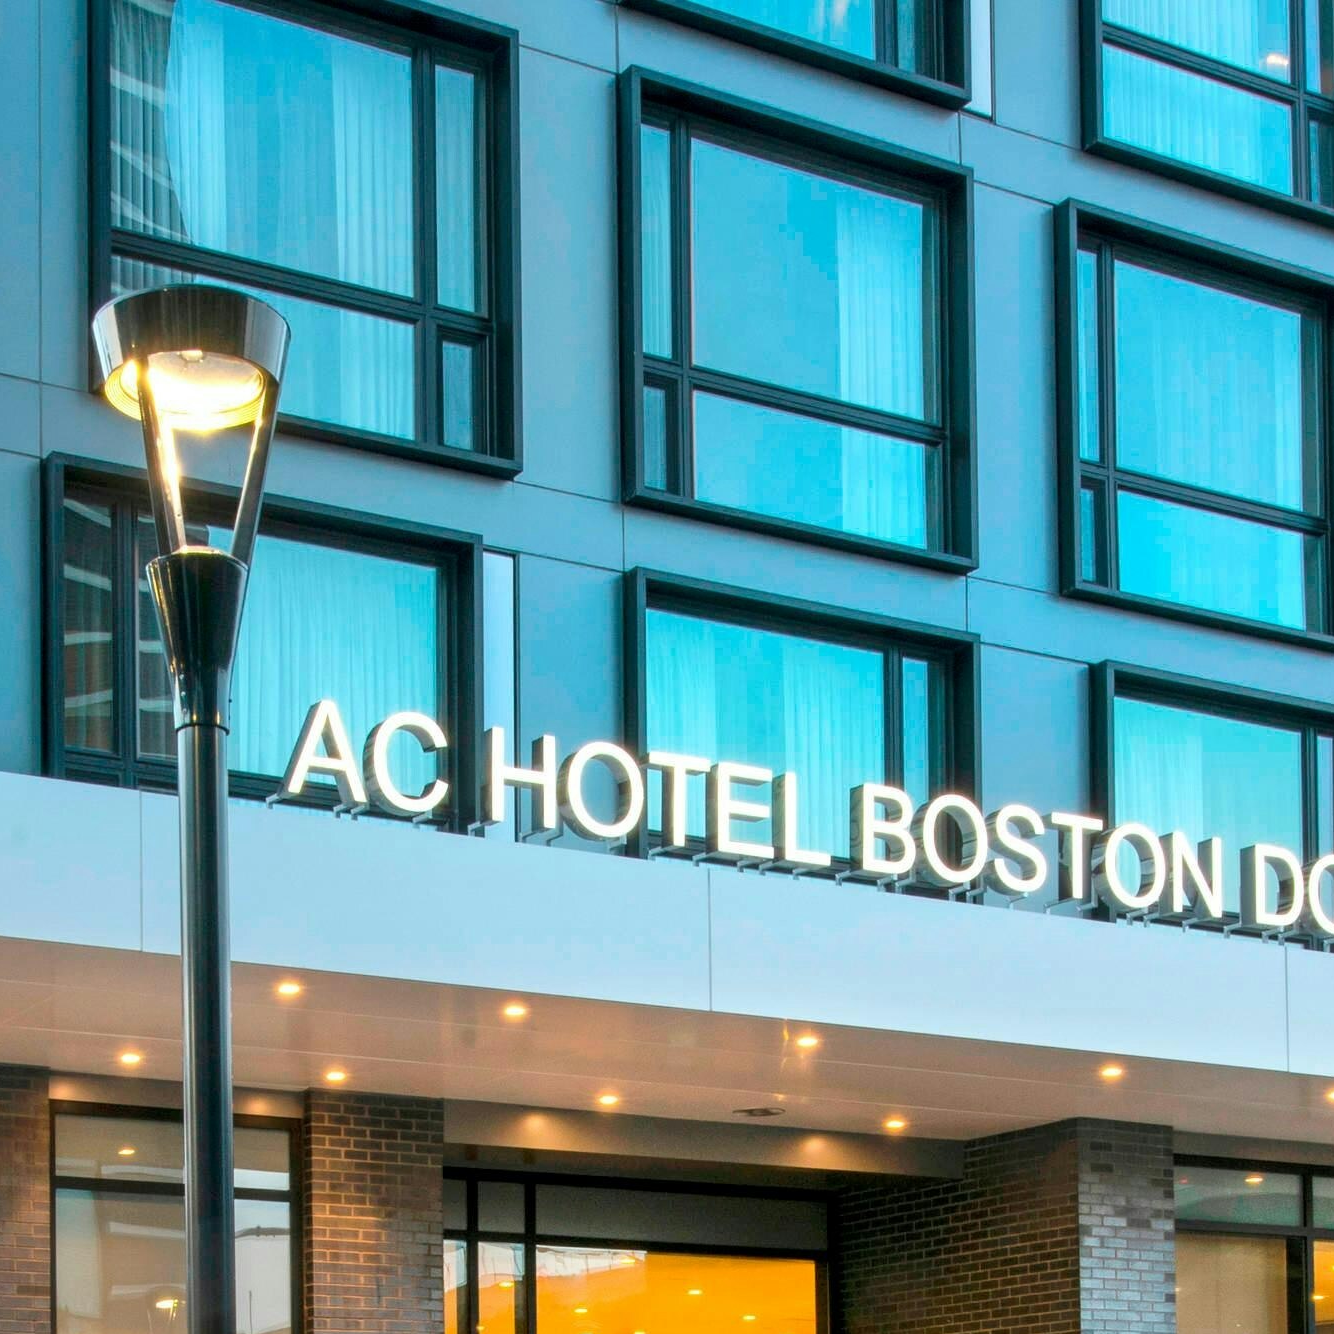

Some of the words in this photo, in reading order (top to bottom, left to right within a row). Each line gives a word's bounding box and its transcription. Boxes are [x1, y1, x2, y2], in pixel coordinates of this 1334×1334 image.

[285, 698, 450, 814] AC
[482, 725, 832, 867] HOTEL
[858, 781, 1223, 919] BOSTON
